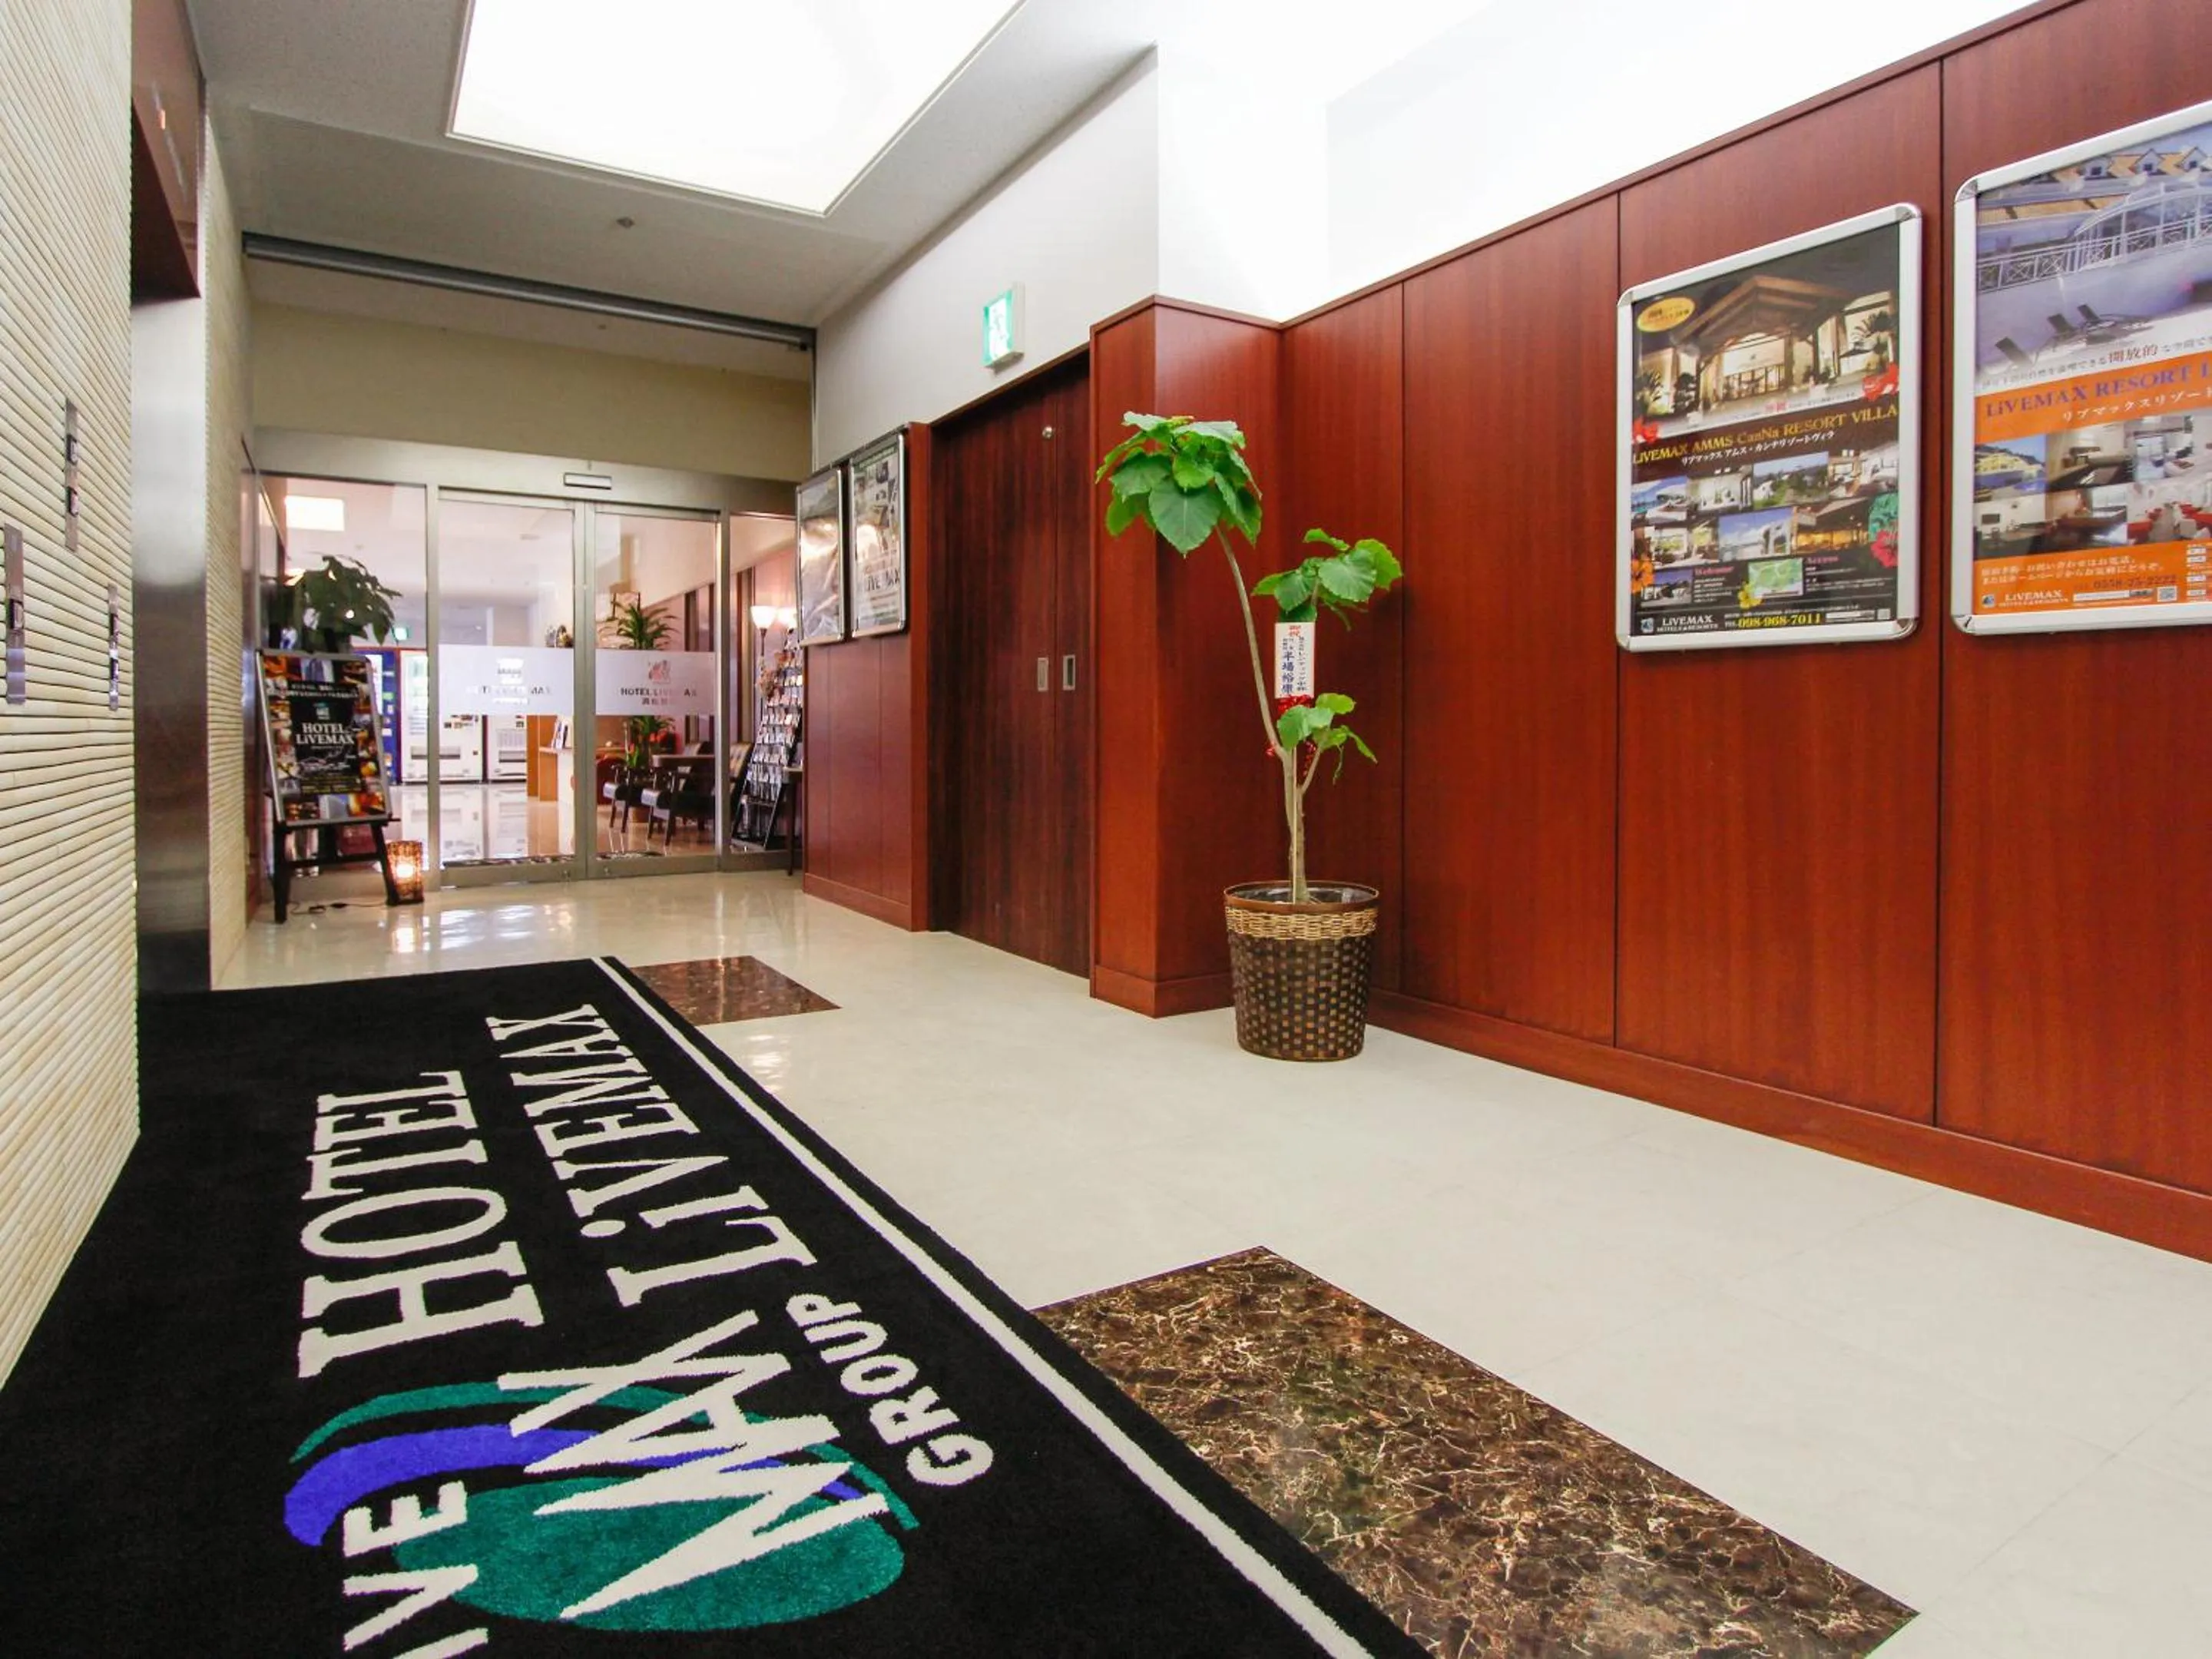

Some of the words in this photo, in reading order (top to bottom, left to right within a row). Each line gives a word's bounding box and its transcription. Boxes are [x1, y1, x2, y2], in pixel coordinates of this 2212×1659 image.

[2095, 364, 2190, 397] RESORT
[1692, 434, 1734, 453] AMMS
[1783, 412, 1847, 438] RESORT
[1851, 404, 1898, 424] VILLA
[620, 687, 651, 696] HOTEL
[302, 722, 344, 734] HOTEL
[298, 1071, 544, 1378] HOTEL
[786, 1293, 994, 1486] GROUP
[498, 1310, 889, 1620] MAX
